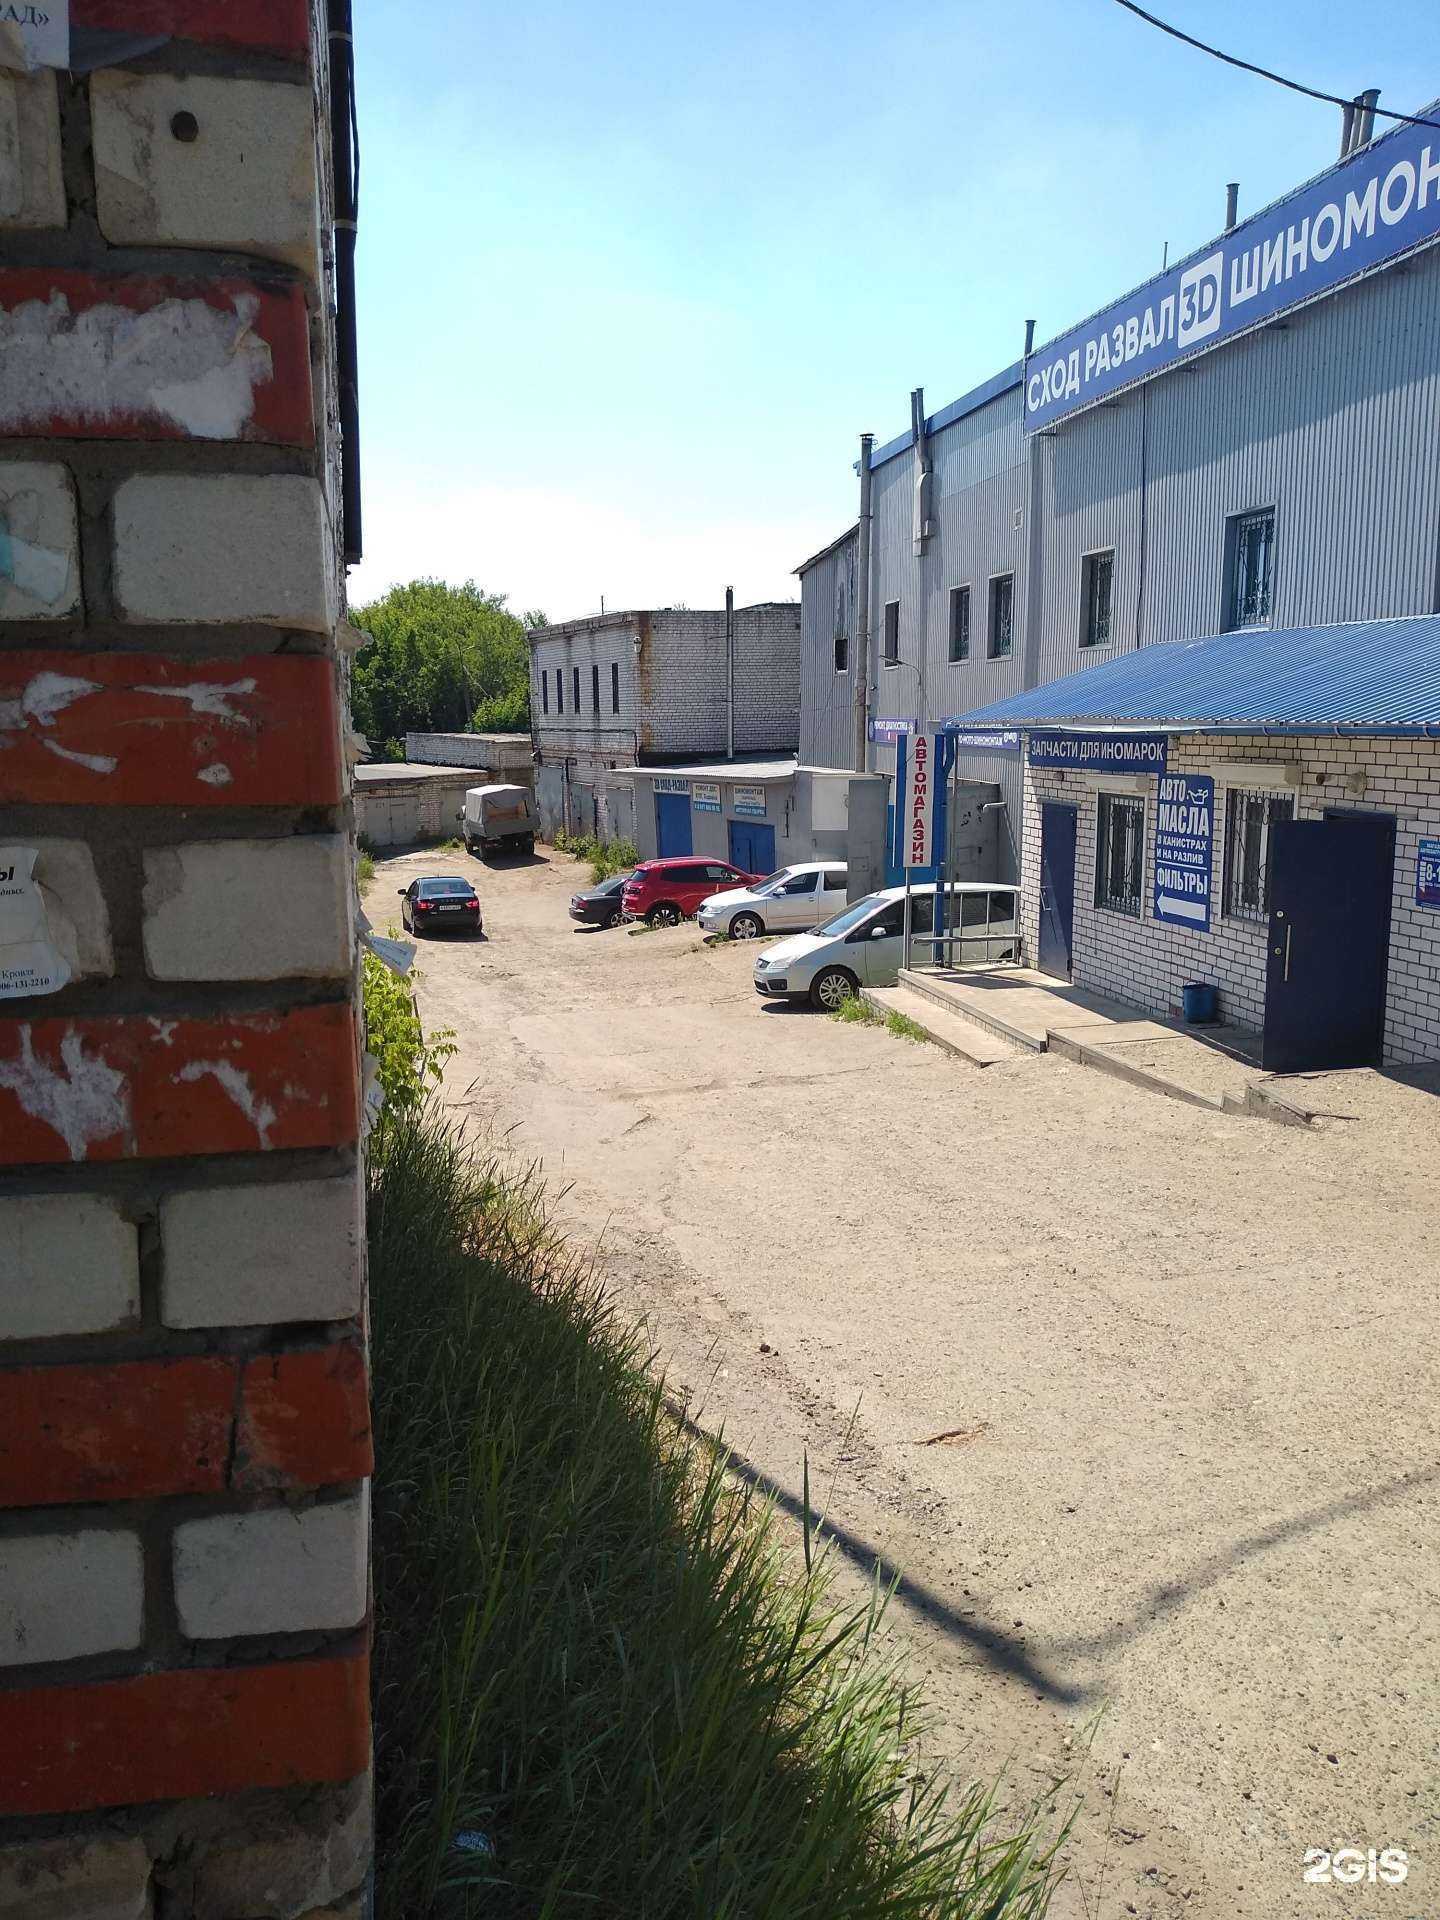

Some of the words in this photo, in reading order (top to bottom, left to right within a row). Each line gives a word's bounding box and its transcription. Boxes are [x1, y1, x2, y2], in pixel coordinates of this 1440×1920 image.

[0, 5, 49, 28] АД»
[1027, 349, 1080, 412] СХОД
[1085, 294, 1175, 382] РАЗВАЛ
[1180, 272, 1218, 332] 3D
[1229, 146, 1440, 308] ШИНОМОН
[1032, 740, 1078, 757] ЗАПЧАСТИ
[1080, 741, 1100, 760] ДЛЯ
[1101, 742, 1164, 760] ИНОМАРОК
[912, 736, 927, 864] АВТОМАГАЗИН
[1160, 779, 1186, 802] АВТО
[1159, 804, 1209, 836] МАСЛА
[1163, 836, 1207, 850] КАНИСТРАХ
[1156, 848, 1161, 858] И
[1163, 849, 1172, 860] НА
[1174, 851, 1203, 864] РАЗЛИВ
[1157, 867, 1207, 895] ФИЛЬТРЫ
